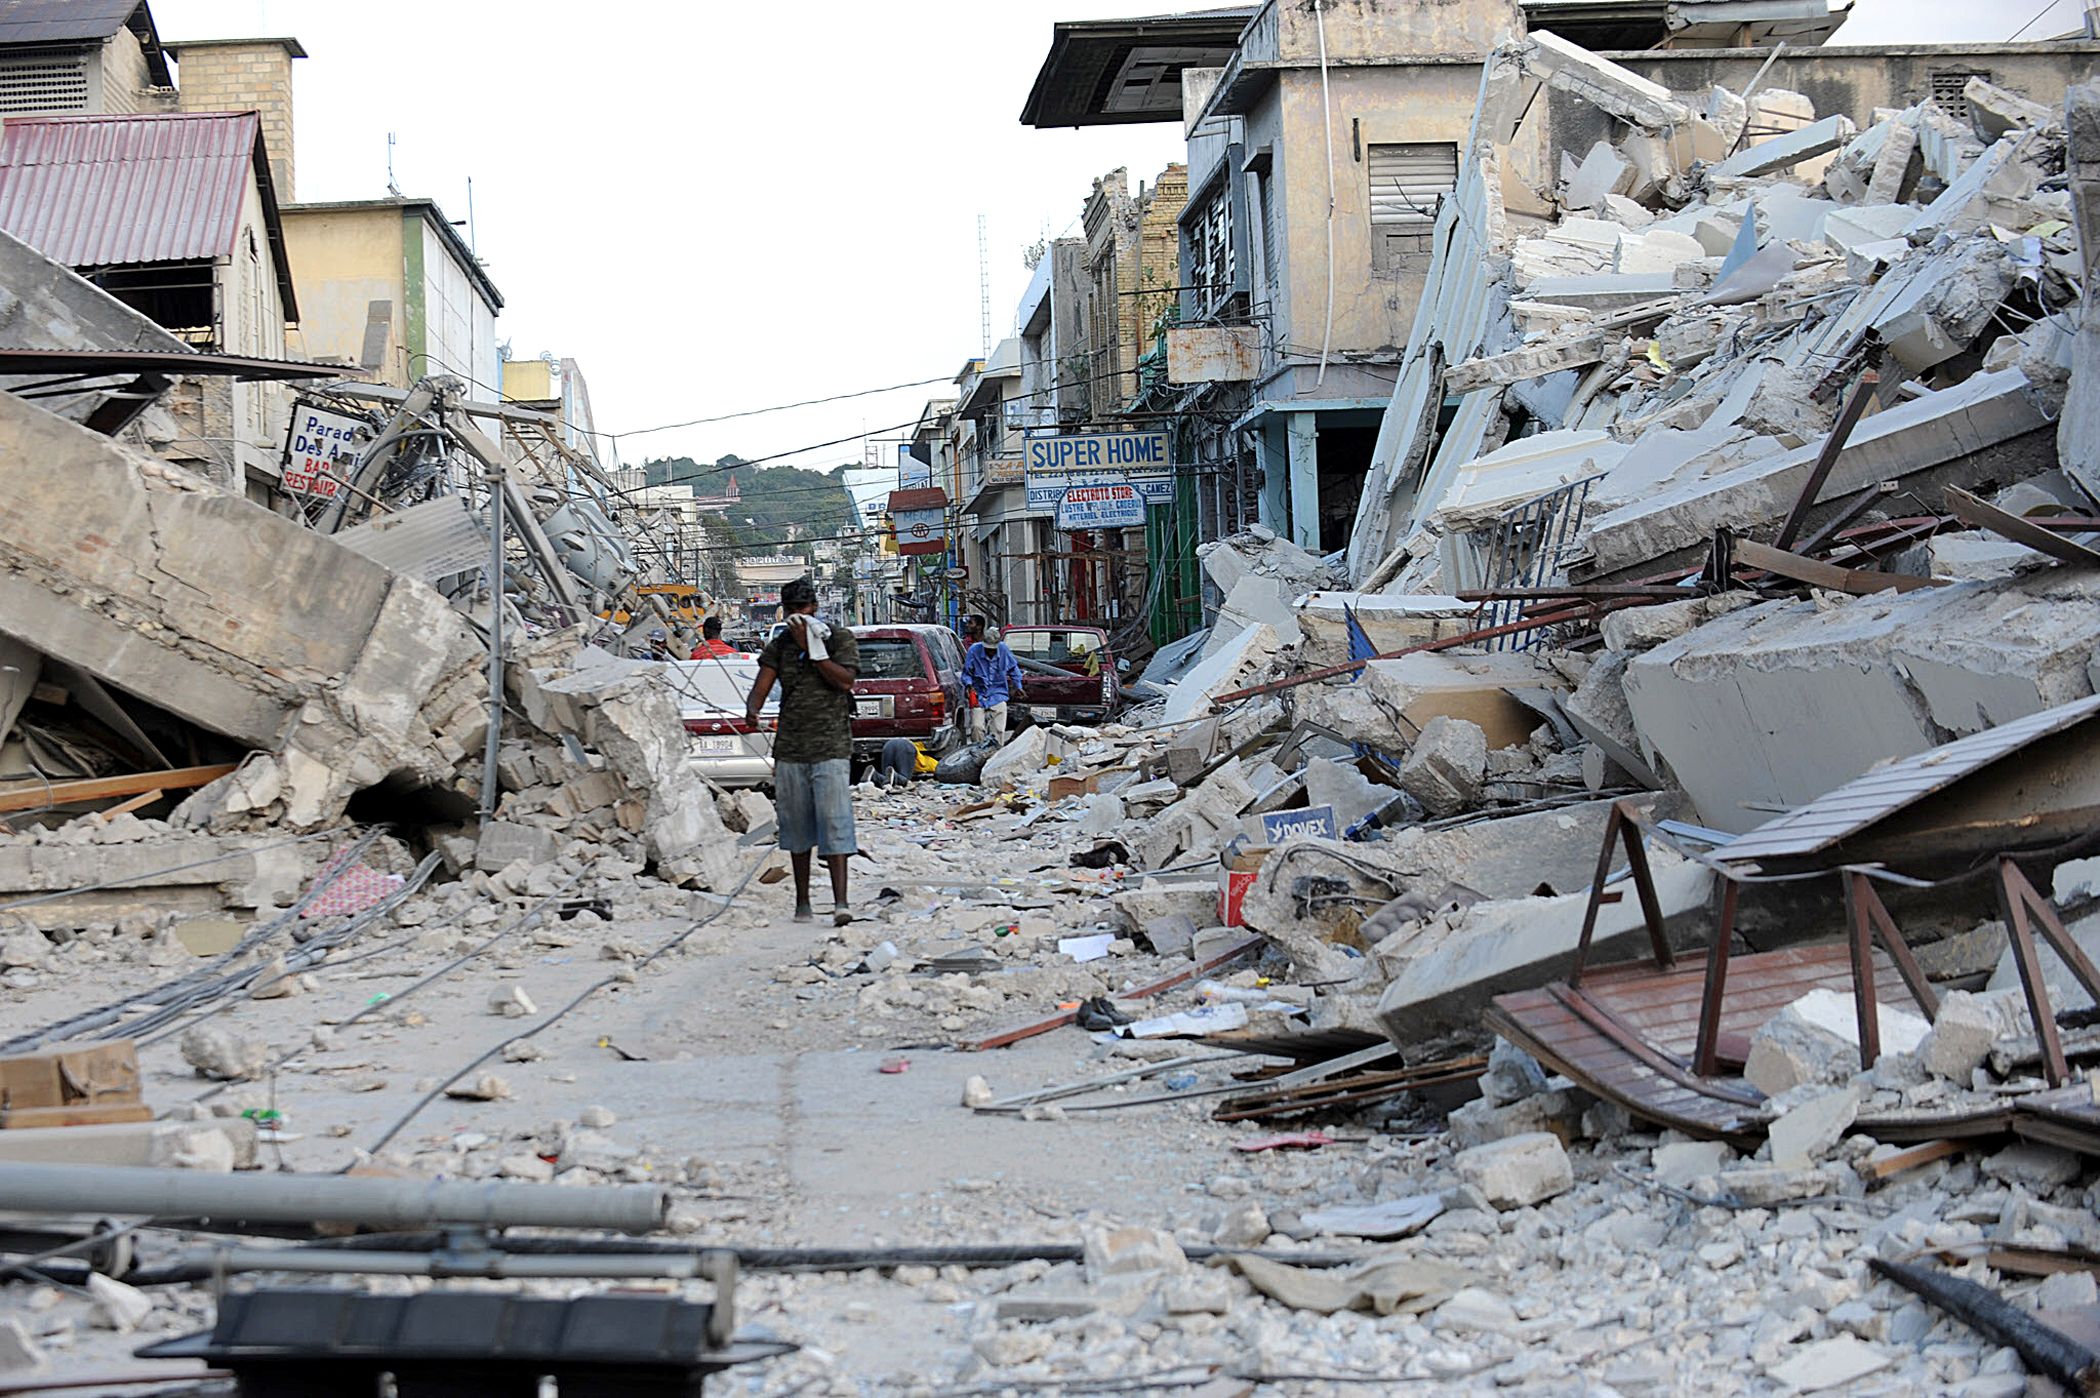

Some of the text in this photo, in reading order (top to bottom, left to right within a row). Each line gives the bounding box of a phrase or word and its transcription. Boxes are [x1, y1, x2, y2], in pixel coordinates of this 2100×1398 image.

[306, 416, 354, 441] Parad
[1032, 436, 1163, 468] SUPER HOME
[1112, 486, 1133, 500] STORE
[1061, 502, 1084, 513] LUSTRE
[904, 509, 934, 522] MEGA
